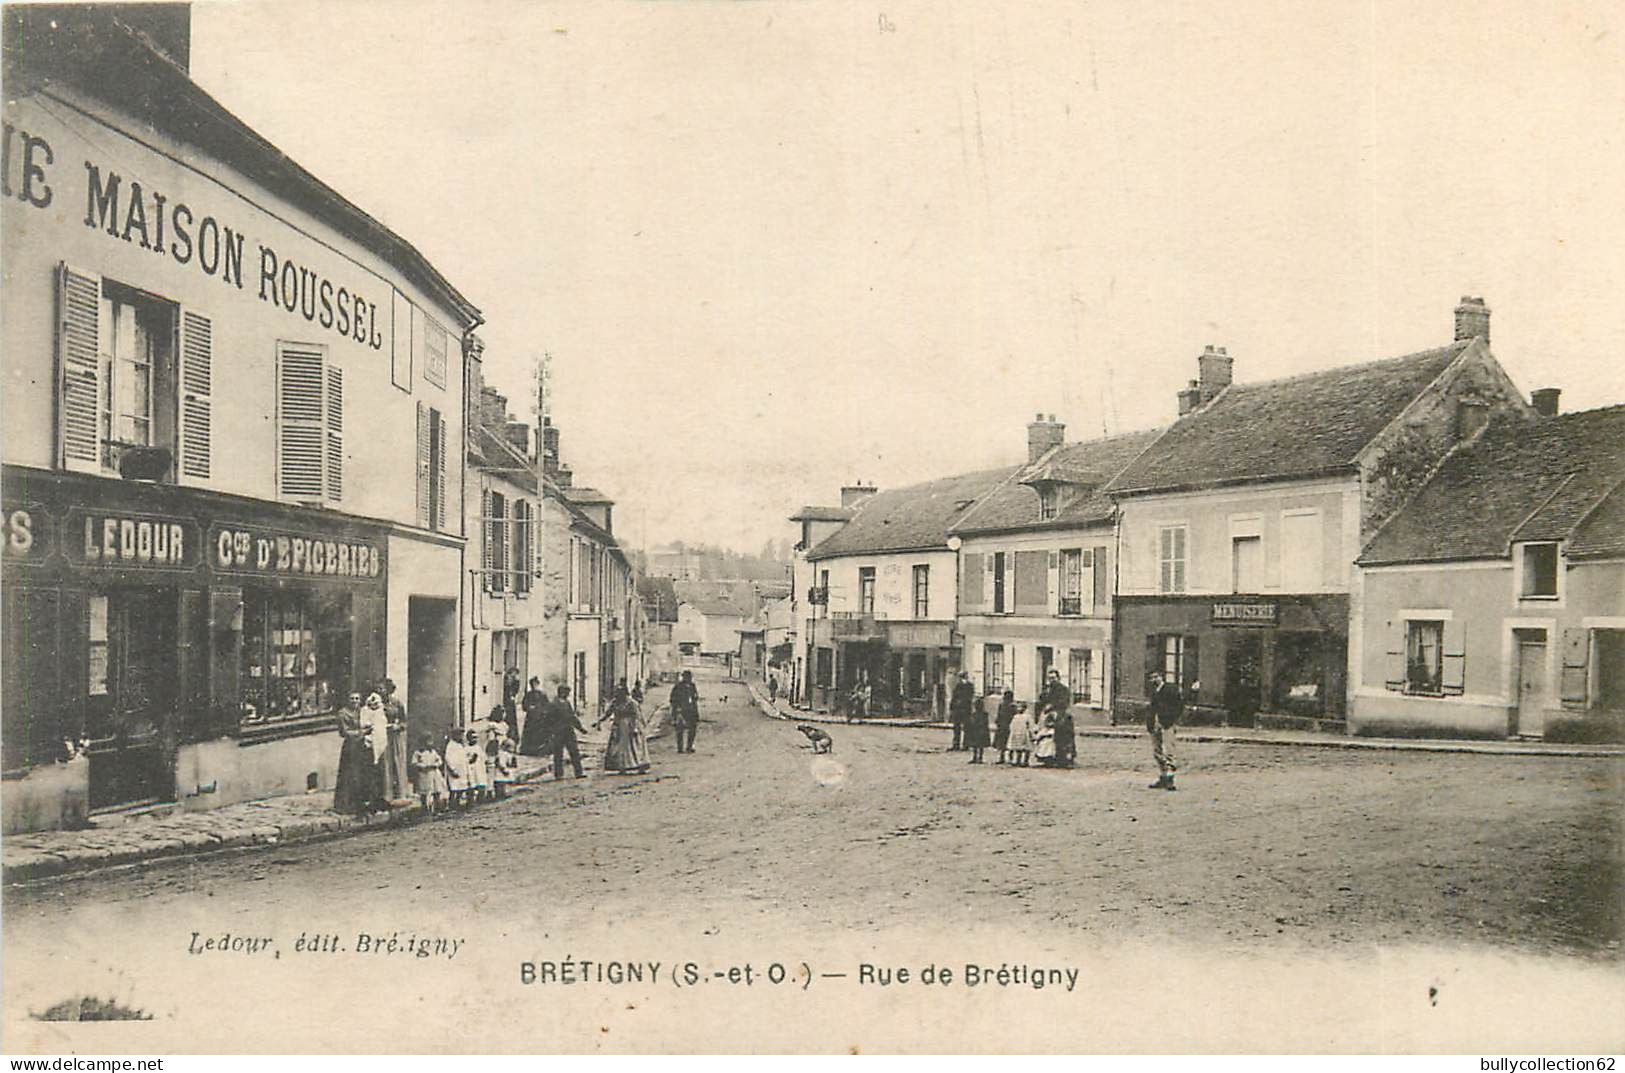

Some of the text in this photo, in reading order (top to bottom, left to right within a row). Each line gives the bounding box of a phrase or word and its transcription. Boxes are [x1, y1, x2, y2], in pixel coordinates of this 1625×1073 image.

[83, 160, 245, 290] MAISON
[258, 244, 382, 350] ROUSSEL
[84, 516, 184, 562] LEDOUR
[189, 932, 281, 959] Ledour,
[295, 932, 346, 953] édit.
[520, 956, 662, 984] BRÉTIGNY
[859, 964, 911, 985] Rue
[920, 963, 954, 985] de
[965, 963, 1080, 990] Brétigny
